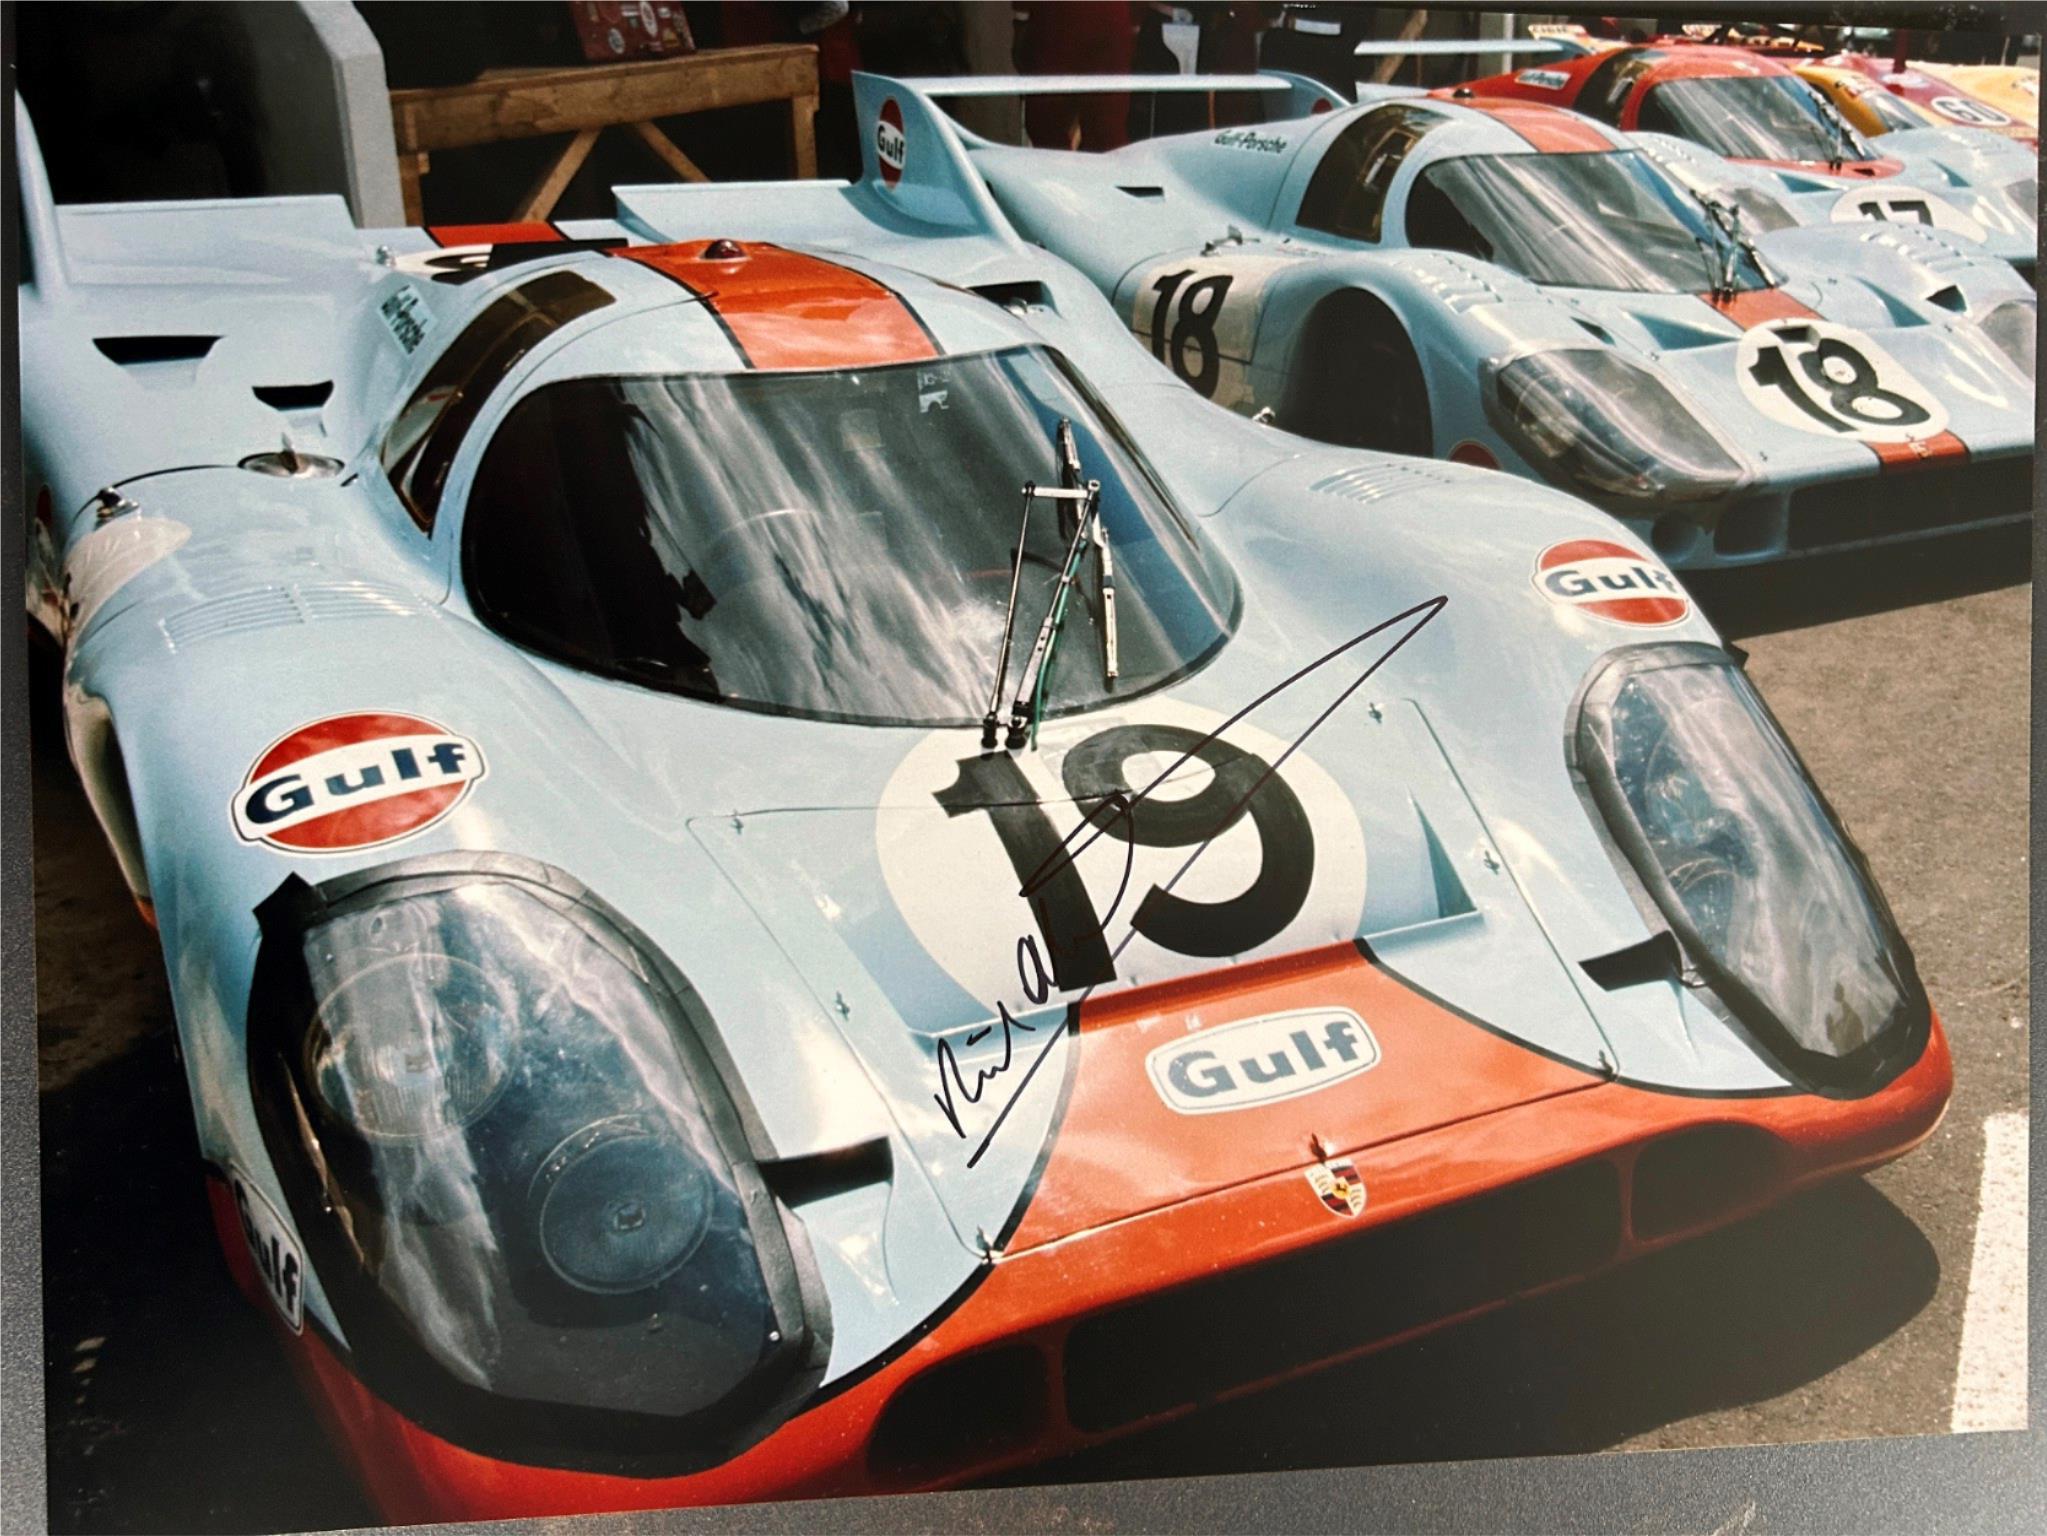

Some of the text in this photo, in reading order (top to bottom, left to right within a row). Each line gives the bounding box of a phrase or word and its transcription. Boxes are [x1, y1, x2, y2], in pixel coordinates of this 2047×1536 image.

[877, 124, 904, 164] Gulf
[1151, 268, 1234, 400] 18
[1748, 338, 1931, 433] 18
[1545, 566, 1678, 597] Gulf
[245, 743, 466, 825] Gulf
[931, 723, 1316, 992] 19
[1167, 1021, 1360, 1099] Gulf
[234, 1178, 299, 1315] Gulf
